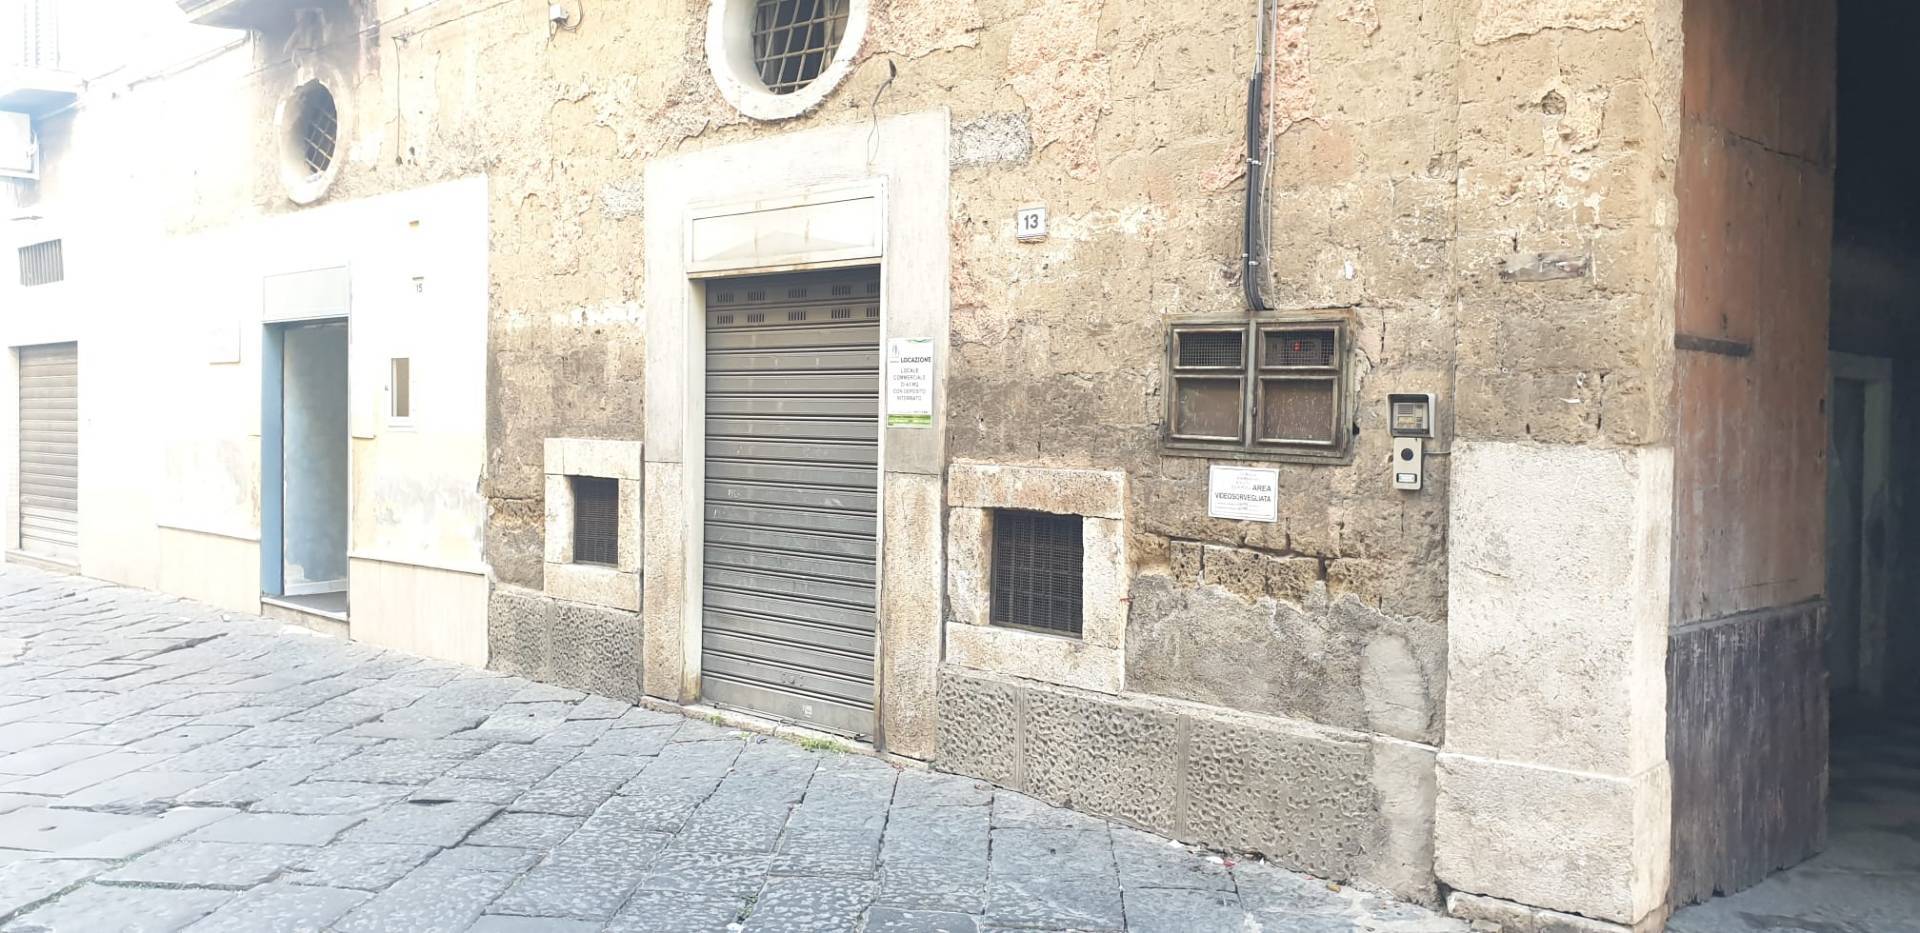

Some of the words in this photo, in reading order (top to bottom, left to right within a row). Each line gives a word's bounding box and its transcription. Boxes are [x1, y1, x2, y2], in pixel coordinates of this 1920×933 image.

[1024, 214, 1039, 230] 13
[1252, 484, 1272, 492] AREA
[1214, 492, 1271, 502] VIDEOSORVEGLIATA
